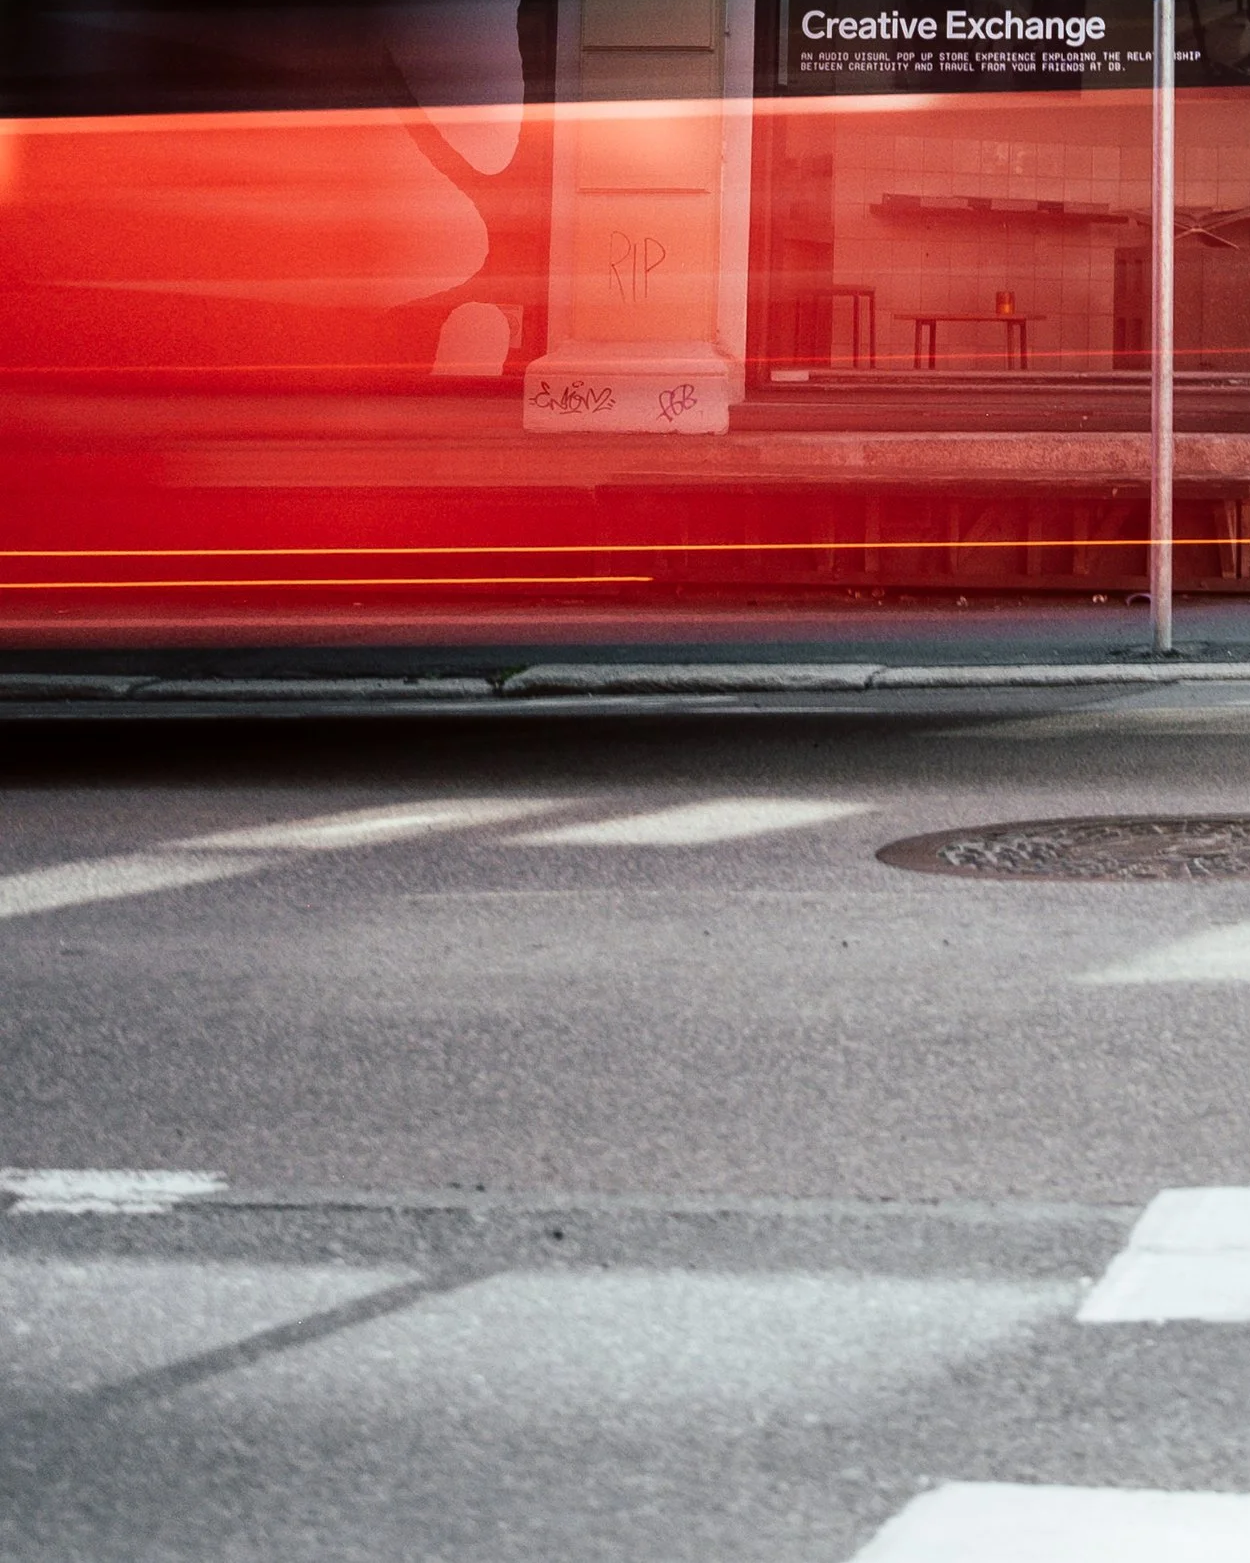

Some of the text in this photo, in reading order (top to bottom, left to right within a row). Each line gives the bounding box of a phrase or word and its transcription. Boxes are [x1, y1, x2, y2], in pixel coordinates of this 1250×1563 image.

[801, 9, 1106, 47] Creative Exchange
[800, 52, 813, 61] AN
[818, 52, 849, 61] AUDIO
[854, 52, 890, 61] VISUAL
[896, 52, 915, 61] POP
[920, 52, 933, 61] UP
[939, 52, 969, 61] STORE
[975, 52, 1036, 61] EXPERIENCE
[1042, 52, 1096, 61] EXPLORING
[1103, 52, 1120, 61] THE
[800, 62, 843, 71] BETWEEN
[848, 62, 909, 71] CREATIVITY
[914, 62, 933, 71] AND
[939, 62, 975, 71] TRAVEL
[981, 62, 1006, 71] FROM
[1011, 62, 1036, 71] YOUR
[1042, 62, 1085, 71] FRIENDS
[1090, 62, 1102, 71] AT
[608, 230, 666, 303] RIP
